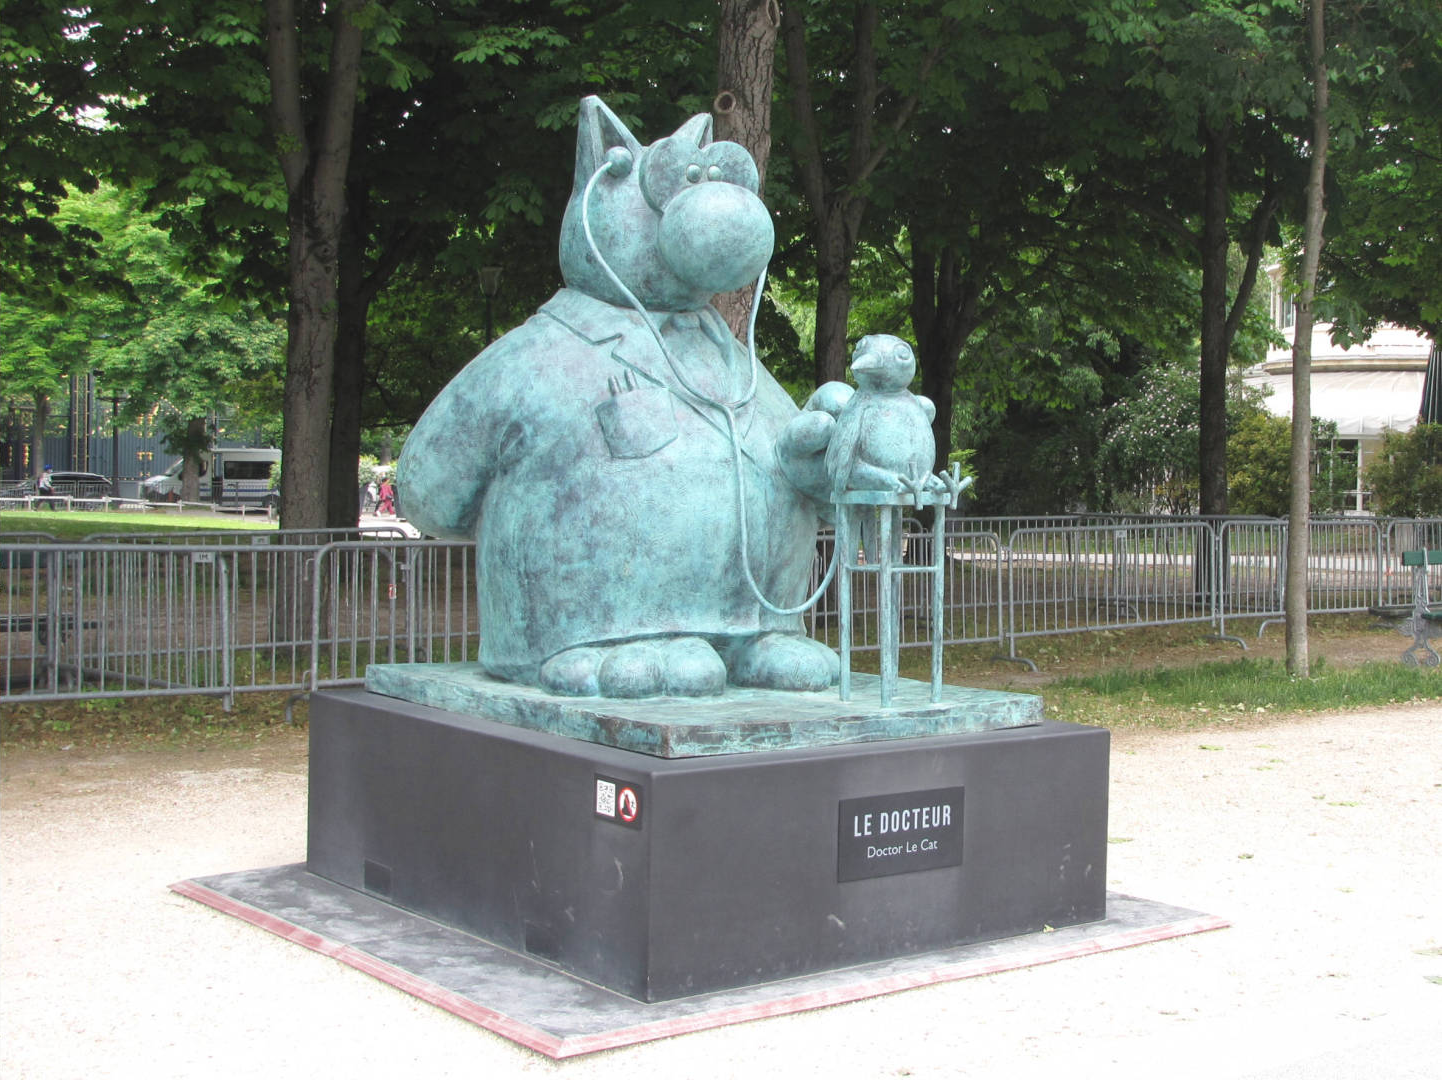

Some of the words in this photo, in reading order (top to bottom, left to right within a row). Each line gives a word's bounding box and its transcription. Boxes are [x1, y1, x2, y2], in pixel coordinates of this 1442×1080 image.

[854, 814, 872, 837] LE
[880, 805, 951, 834] DOCTEUR
[867, 846, 903, 858] Doctor
[906, 841, 918, 853] Le
[921, 839, 938, 851] Cat
